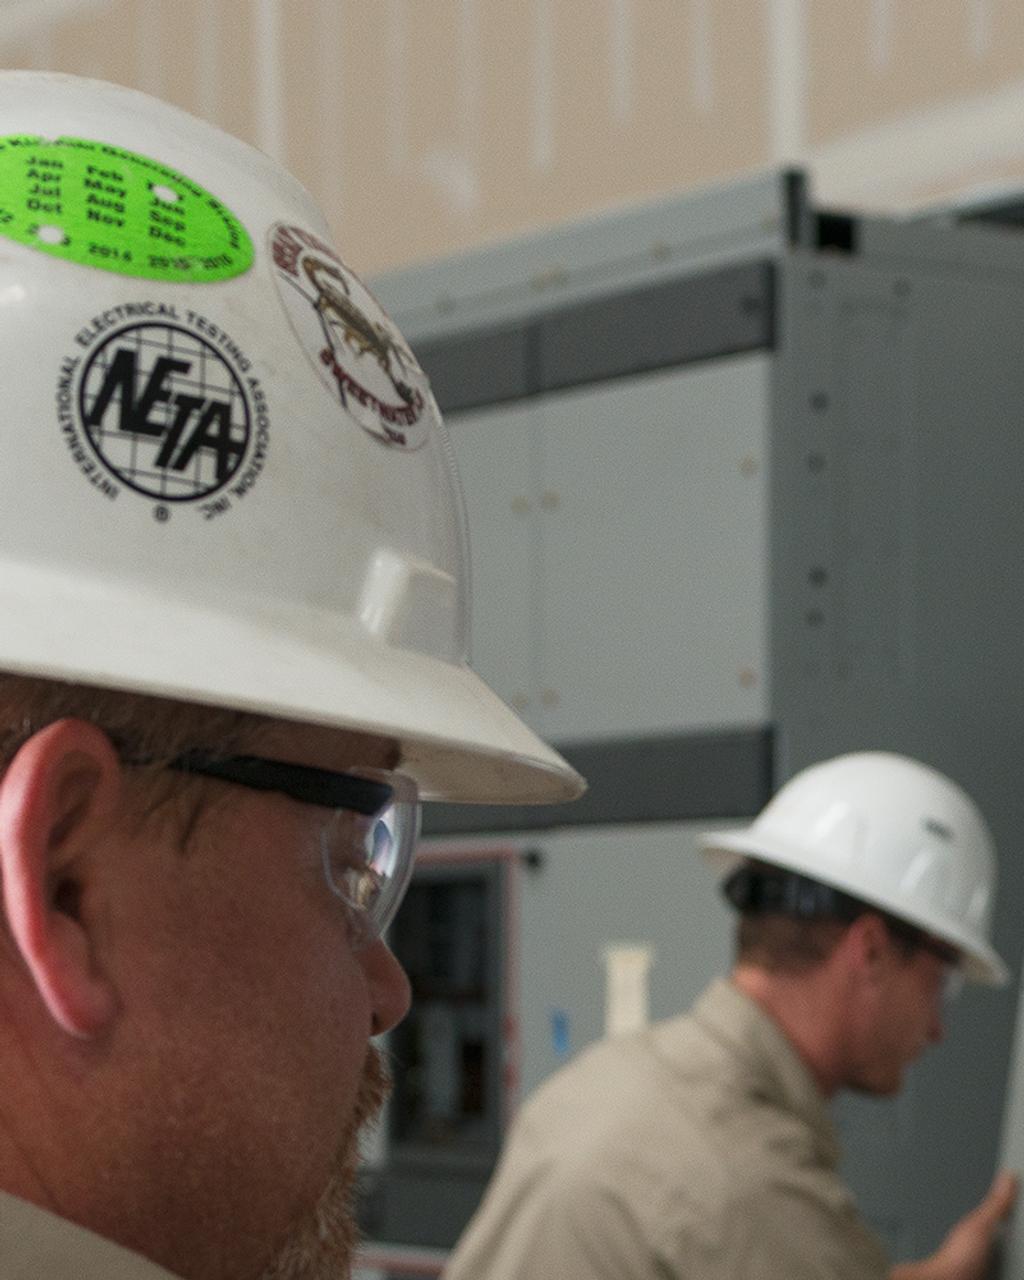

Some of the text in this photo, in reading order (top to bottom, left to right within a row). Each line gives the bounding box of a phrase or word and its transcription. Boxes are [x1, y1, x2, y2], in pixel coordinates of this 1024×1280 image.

[27, 156, 124, 182] Jan Feb
[27, 168, 62, 183] Apr
[84, 178, 127, 199] May
[27, 199, 187, 247] Oct Nov Dec
[30, 184, 62, 198] Jul
[87, 193, 126, 214] Aug
[74, 301, 180, 349] ELECTRICAL
[185, 309, 252, 373] TESTING
[55, 355, 121, 501] INTERNATIONAL
[87, 347, 248, 481] NETA
